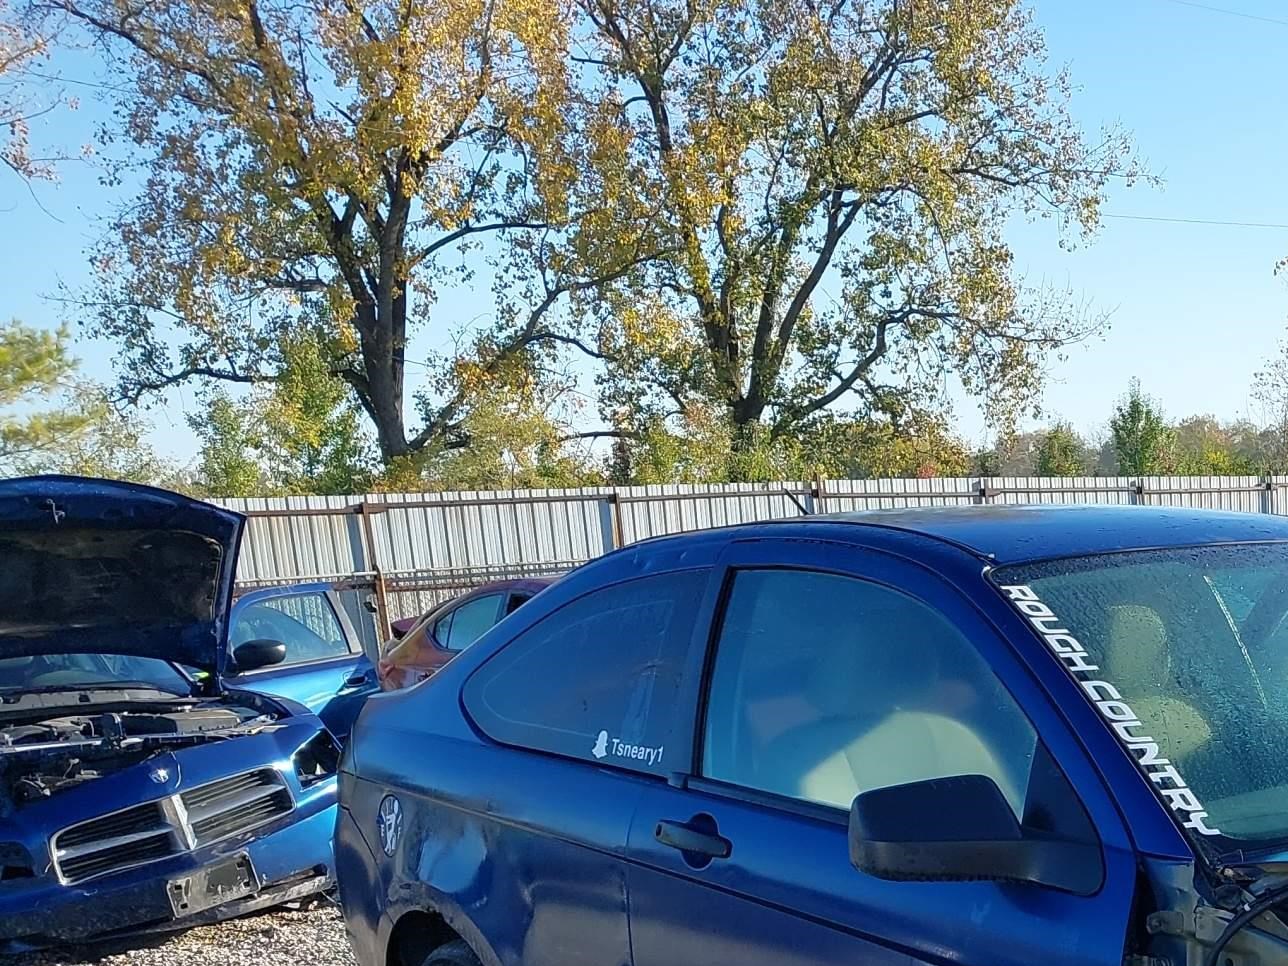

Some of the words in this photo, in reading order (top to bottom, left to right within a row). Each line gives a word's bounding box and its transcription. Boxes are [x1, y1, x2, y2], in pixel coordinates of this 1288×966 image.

[612, 738, 664, 766] Tsneary1
[1000, 585, 1099, 672] ROUGH
[1080, 680, 1221, 835] COUNTRY
